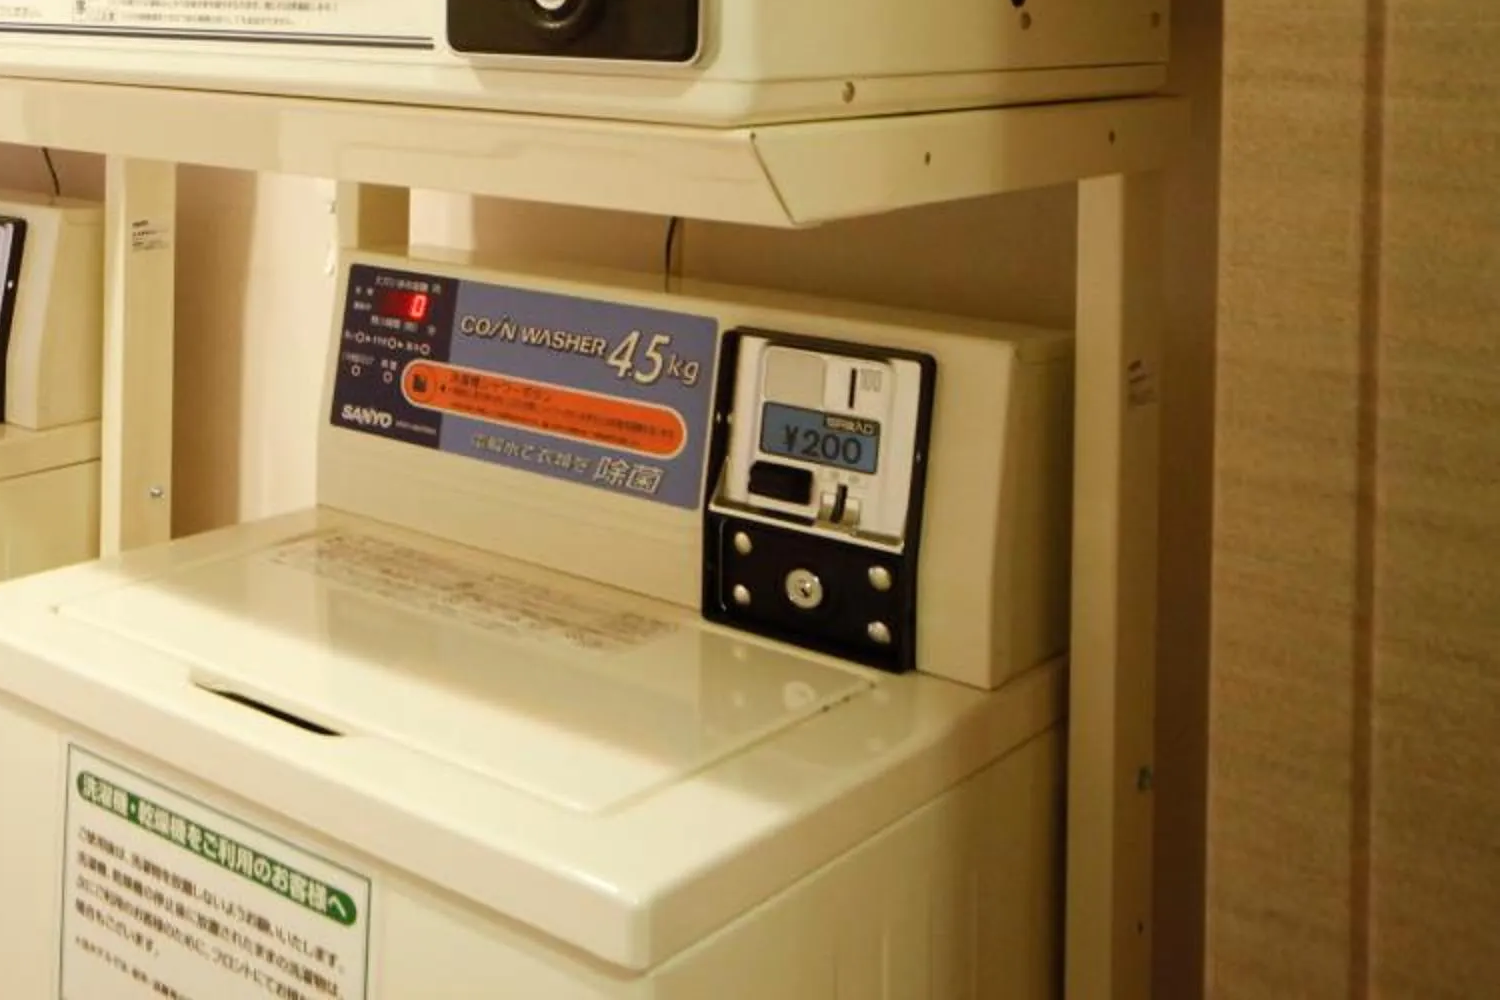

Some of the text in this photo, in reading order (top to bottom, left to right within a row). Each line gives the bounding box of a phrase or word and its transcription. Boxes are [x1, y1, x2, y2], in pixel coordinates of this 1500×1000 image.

[410, 294, 428, 318] 0
[521, 326, 607, 356] WASHER
[341, 404, 392, 429] SANYO
[783, 423, 862, 465] ¥200
[592, 455, 664, 493] 除菌
